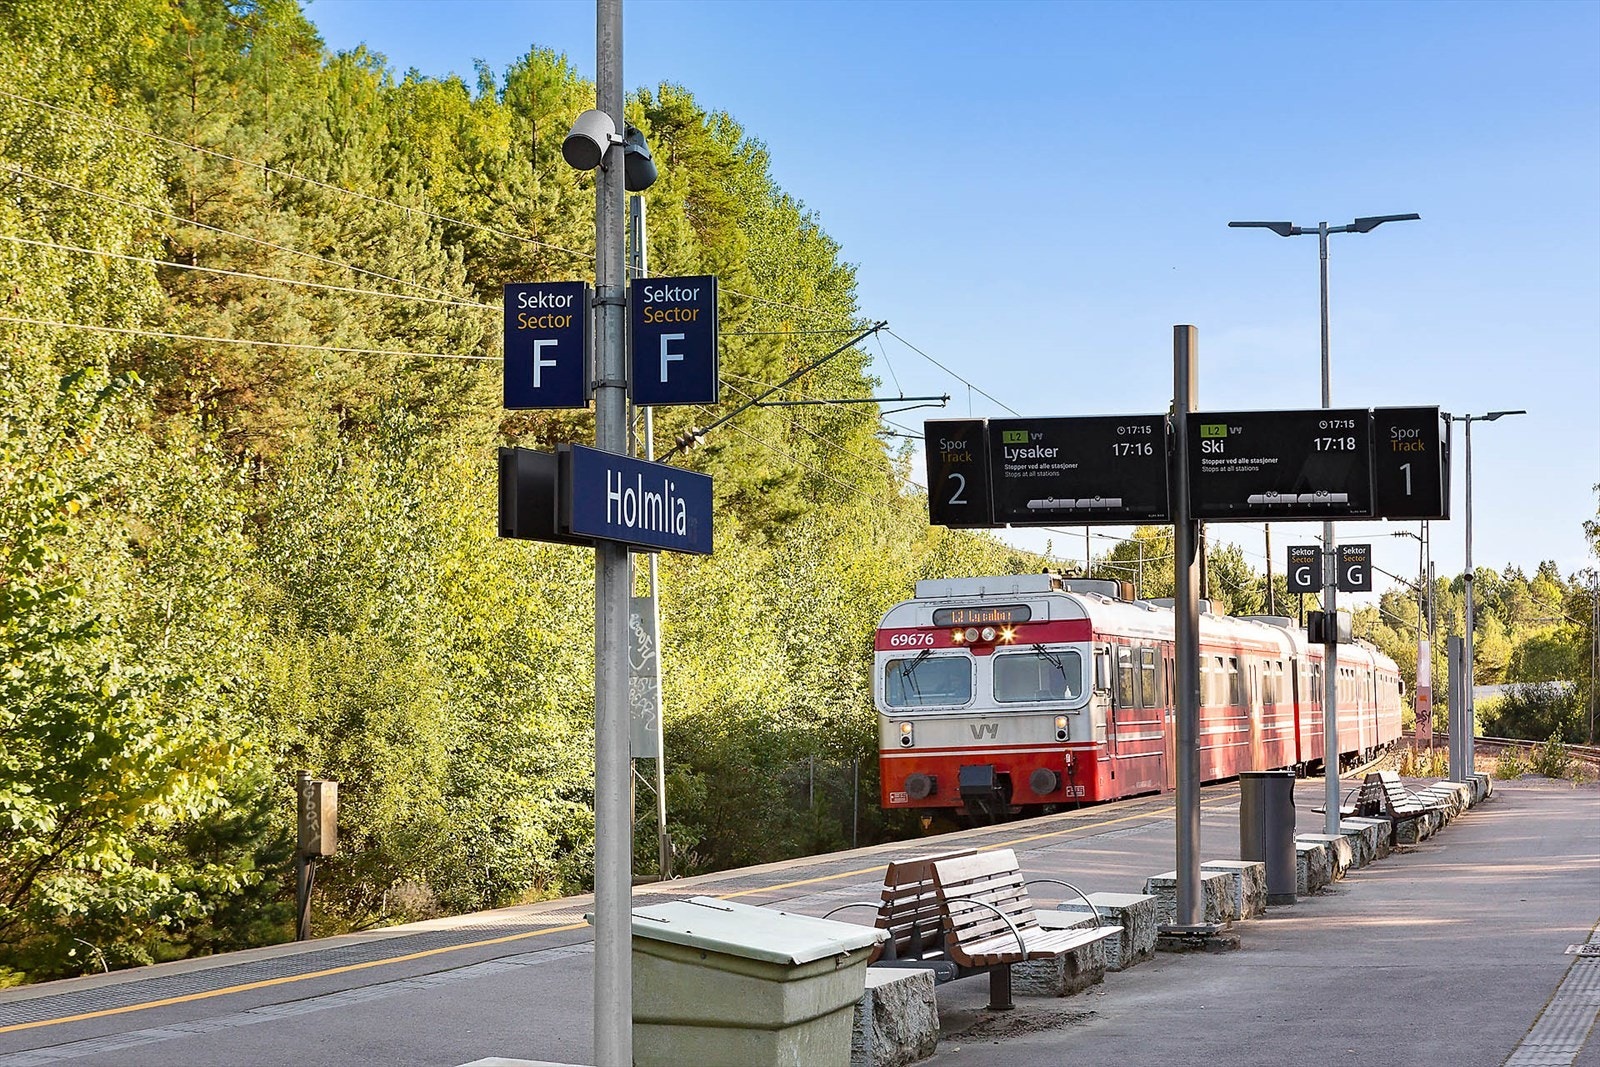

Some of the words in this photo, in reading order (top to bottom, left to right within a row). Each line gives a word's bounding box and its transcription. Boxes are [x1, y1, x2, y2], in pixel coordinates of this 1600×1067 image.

[517, 290, 574, 310] Sektor
[643, 284, 700, 304] Sektor
[517, 312, 573, 330] Sector
[643, 305, 699, 324] Sector
[533, 338, 559, 389] F
[660, 332, 685, 383] F
[1126, 425, 1152, 435] 17:15
[1208, 426, 1220, 435] L2
[1329, 419, 1355, 429] 17:15
[1009, 432, 1022, 441] L2
[1390, 426, 1420, 440] Spor
[939, 438, 967, 451] Spor
[1112, 442, 1153, 457] 17:16
[1201, 439, 1224, 453] Ski
[1314, 437, 1356, 451] 17:18
[1391, 439, 1425, 452] Track
[940, 450, 972, 463] Track
[1004, 444, 1059, 462] Lysaker
[1004, 463, 1027, 471] Stopper
[1051, 462, 1078, 470] stasjoner
[1201, 458, 1225, 466] Stopper
[1250, 456, 1278, 465] stasjoner
[1399, 462, 1412, 497] 1
[948, 472, 968, 505] 2
[606, 469, 687, 537] Holmlia
[1291, 547, 1315, 556] Sektor
[1343, 546, 1366, 555] Sektor
[1291, 555, 1314, 564] Sector
[1343, 554, 1366, 563] Sector
[1295, 566, 1311, 586] G
[1347, 565, 1363, 585] G
[890, 633, 935, 646] 69676
